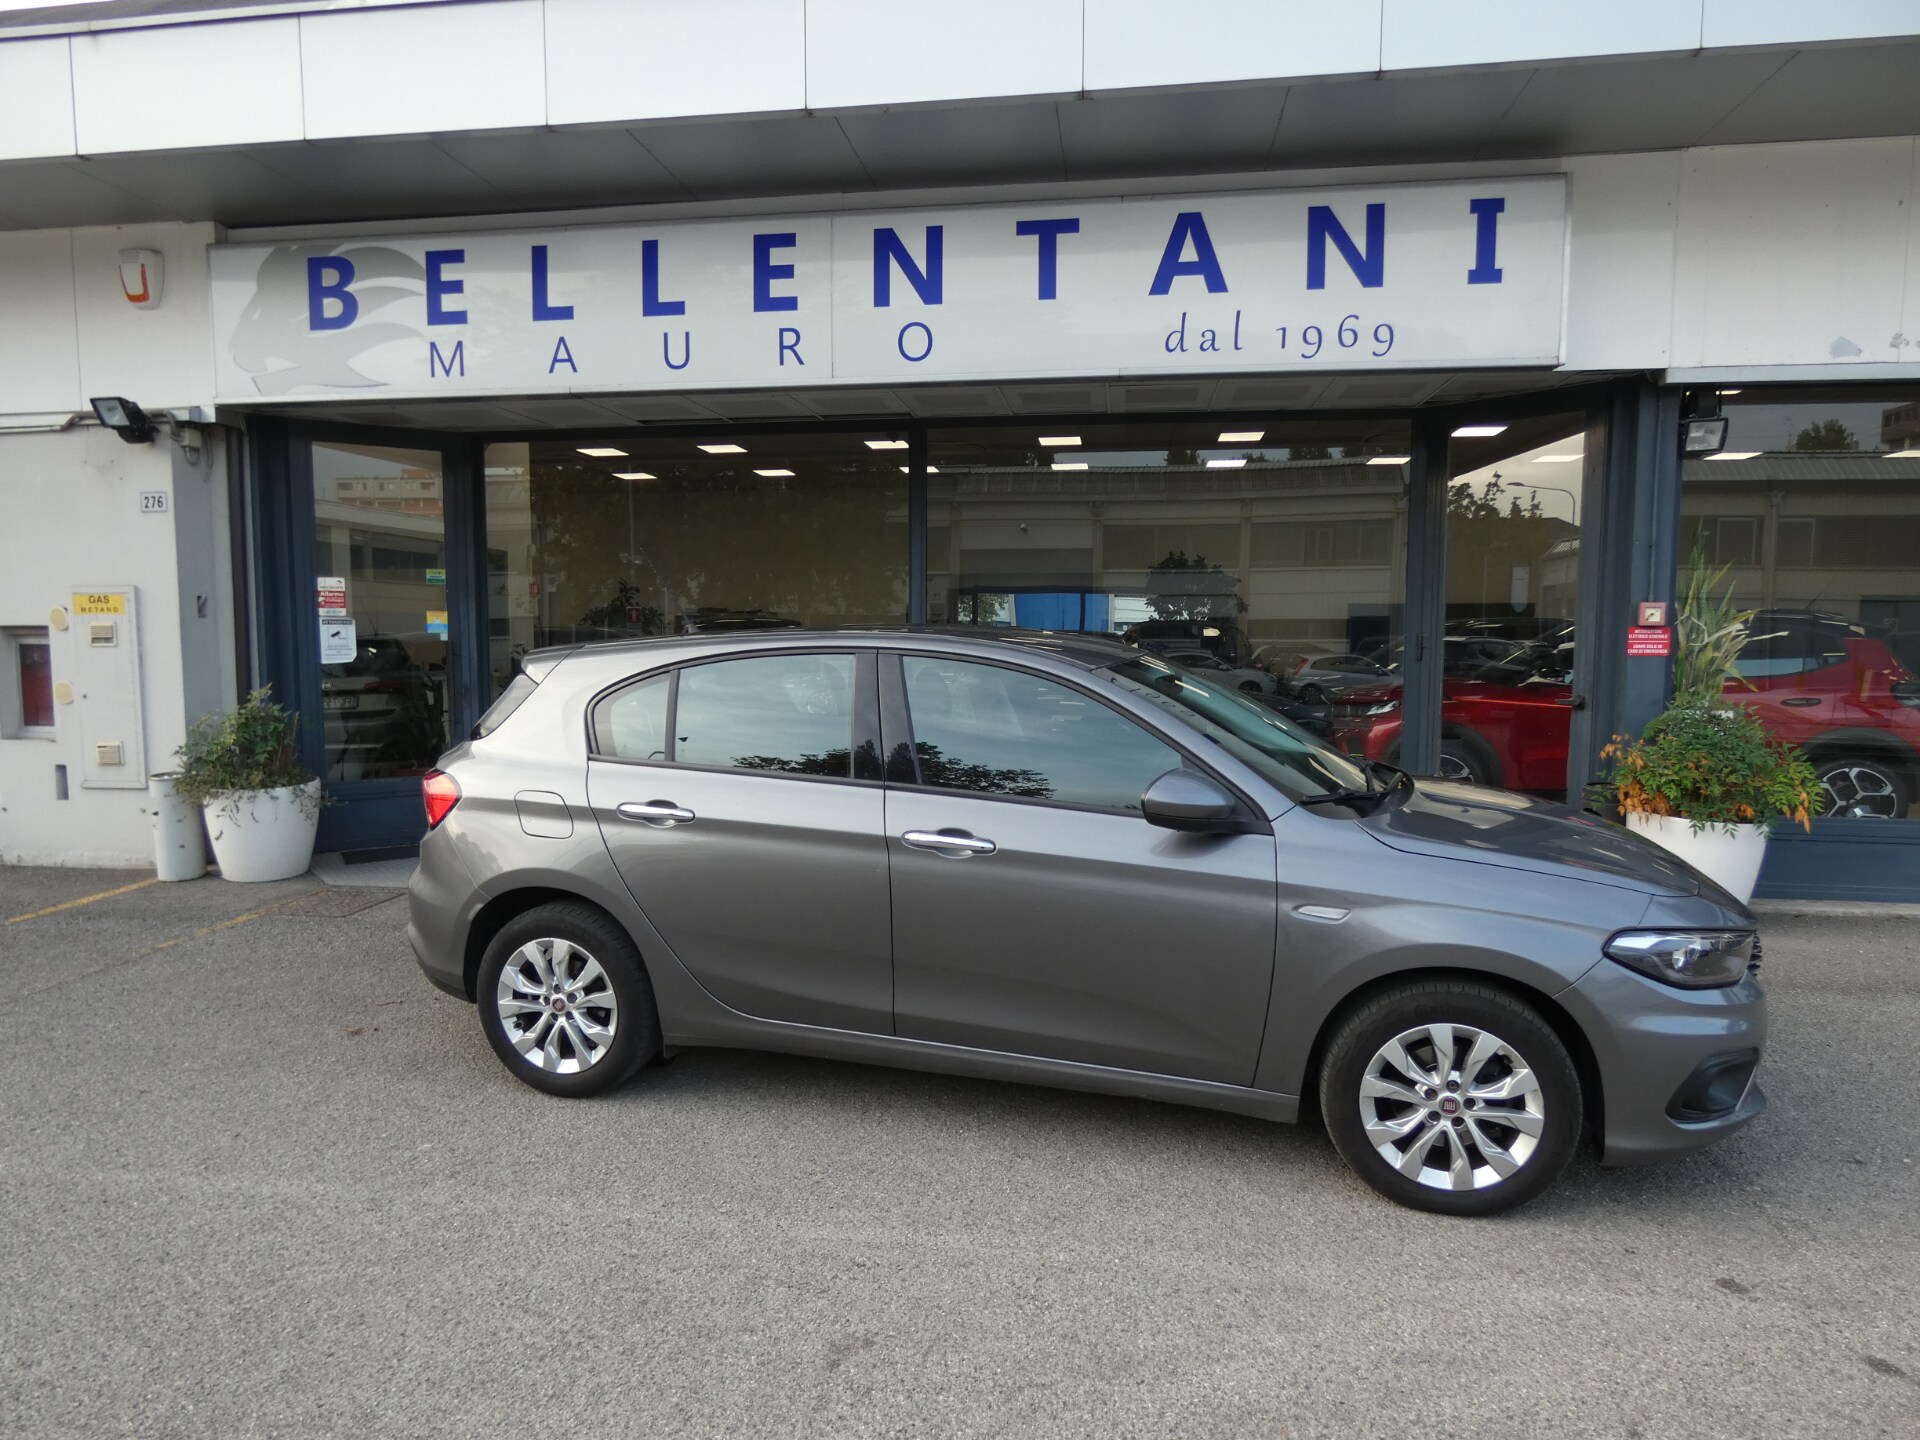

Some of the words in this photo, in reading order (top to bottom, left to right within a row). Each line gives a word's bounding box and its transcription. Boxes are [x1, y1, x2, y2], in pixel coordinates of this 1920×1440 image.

[309, 198, 1505, 331] BELLENTANI
[428, 321, 933, 378] MAURO
[1164, 310, 1243, 353] dal
[1275, 314, 1395, 359] 1969
[144, 495, 164, 509] 276
[88, 595, 110, 604] GAS
